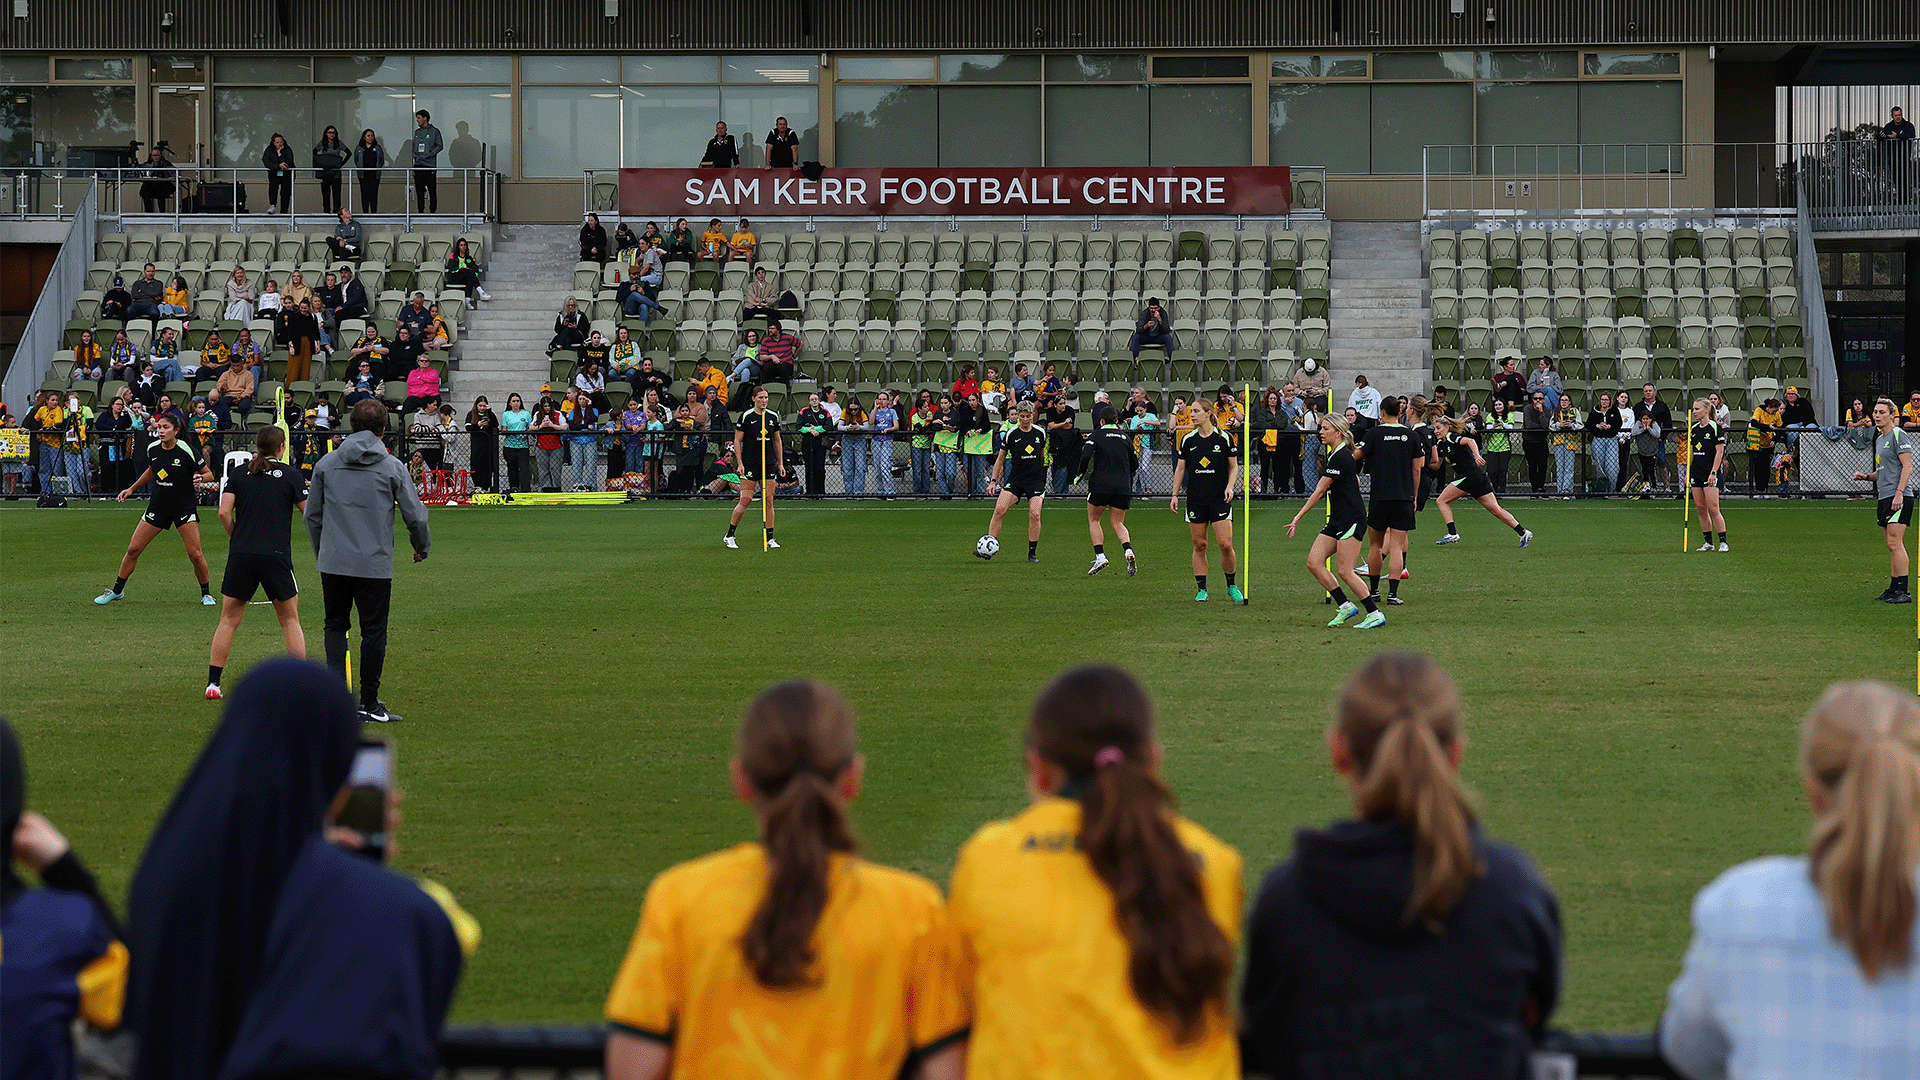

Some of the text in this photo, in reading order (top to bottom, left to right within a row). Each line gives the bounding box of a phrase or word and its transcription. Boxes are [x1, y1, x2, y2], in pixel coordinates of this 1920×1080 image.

[685, 177, 1226, 205] SAM KERR FOOTBALL CENTRE
[1861, 340, 1887, 350] BEST
